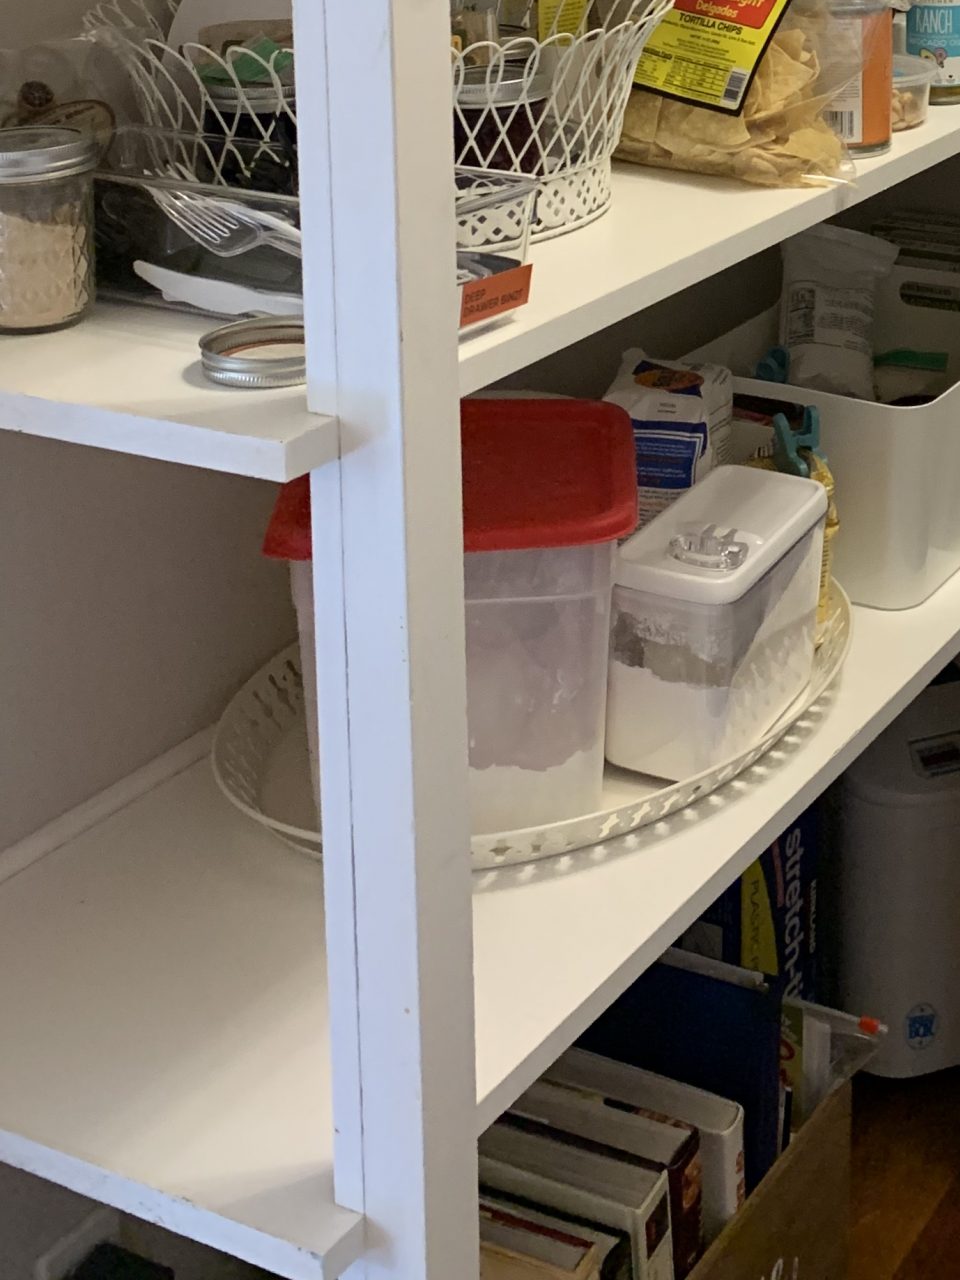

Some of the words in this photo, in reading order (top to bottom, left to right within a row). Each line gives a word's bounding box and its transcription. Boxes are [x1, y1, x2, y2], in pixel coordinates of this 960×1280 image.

[679, 12, 717, 30] TORTILLA
[717, 22, 743, 36] CHIPS
[915, 8, 954, 35] RANCH
[464, 288, 486, 305] DEEP
[783, 827, 804, 999] stretch-ti
